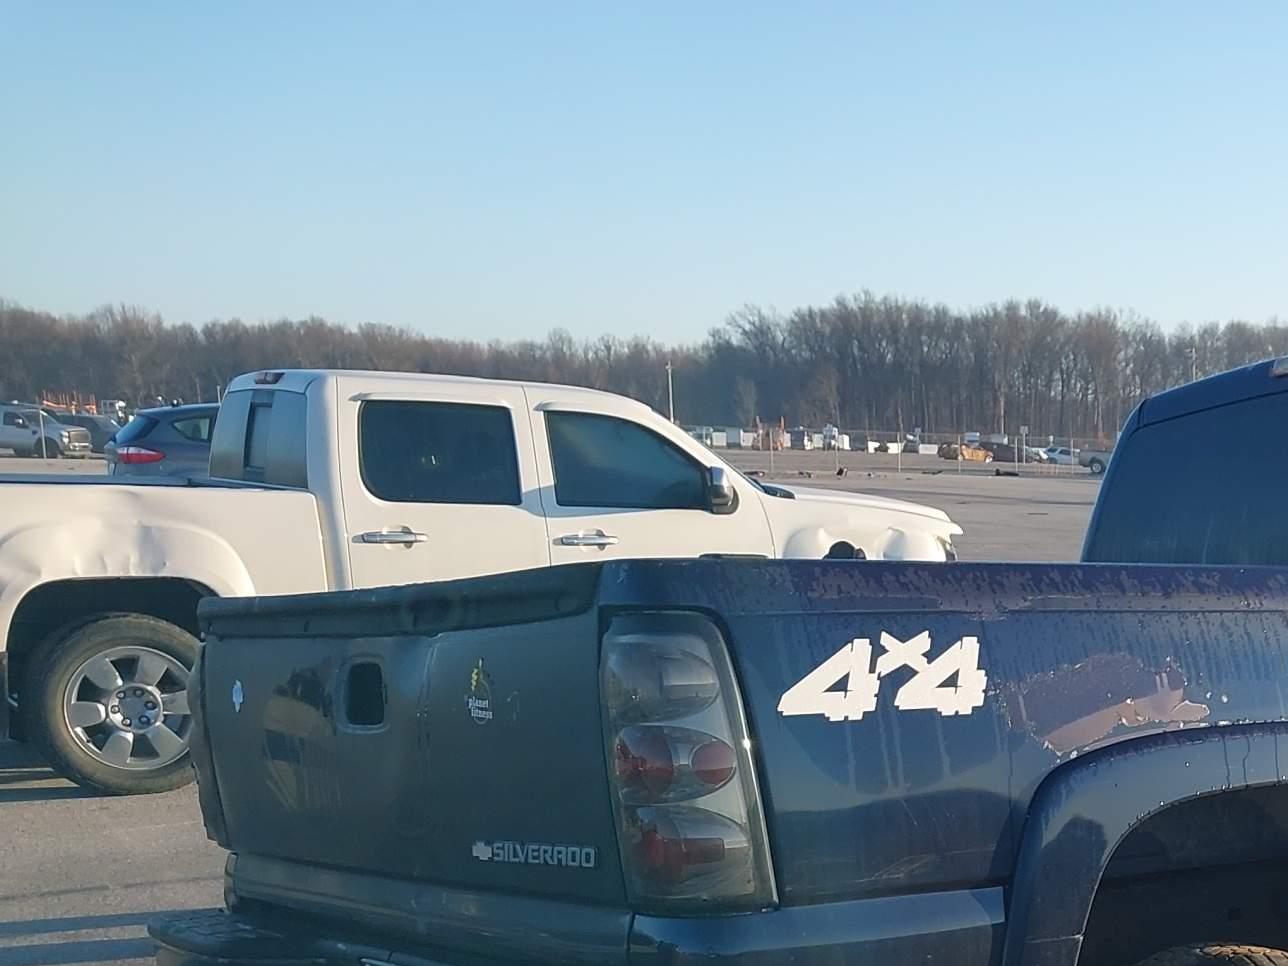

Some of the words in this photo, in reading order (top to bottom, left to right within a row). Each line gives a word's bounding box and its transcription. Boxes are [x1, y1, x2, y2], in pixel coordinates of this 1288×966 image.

[468, 696, 489, 709] planet
[471, 707, 493, 719] fitness
[493, 841, 595, 868] SILVERADO
